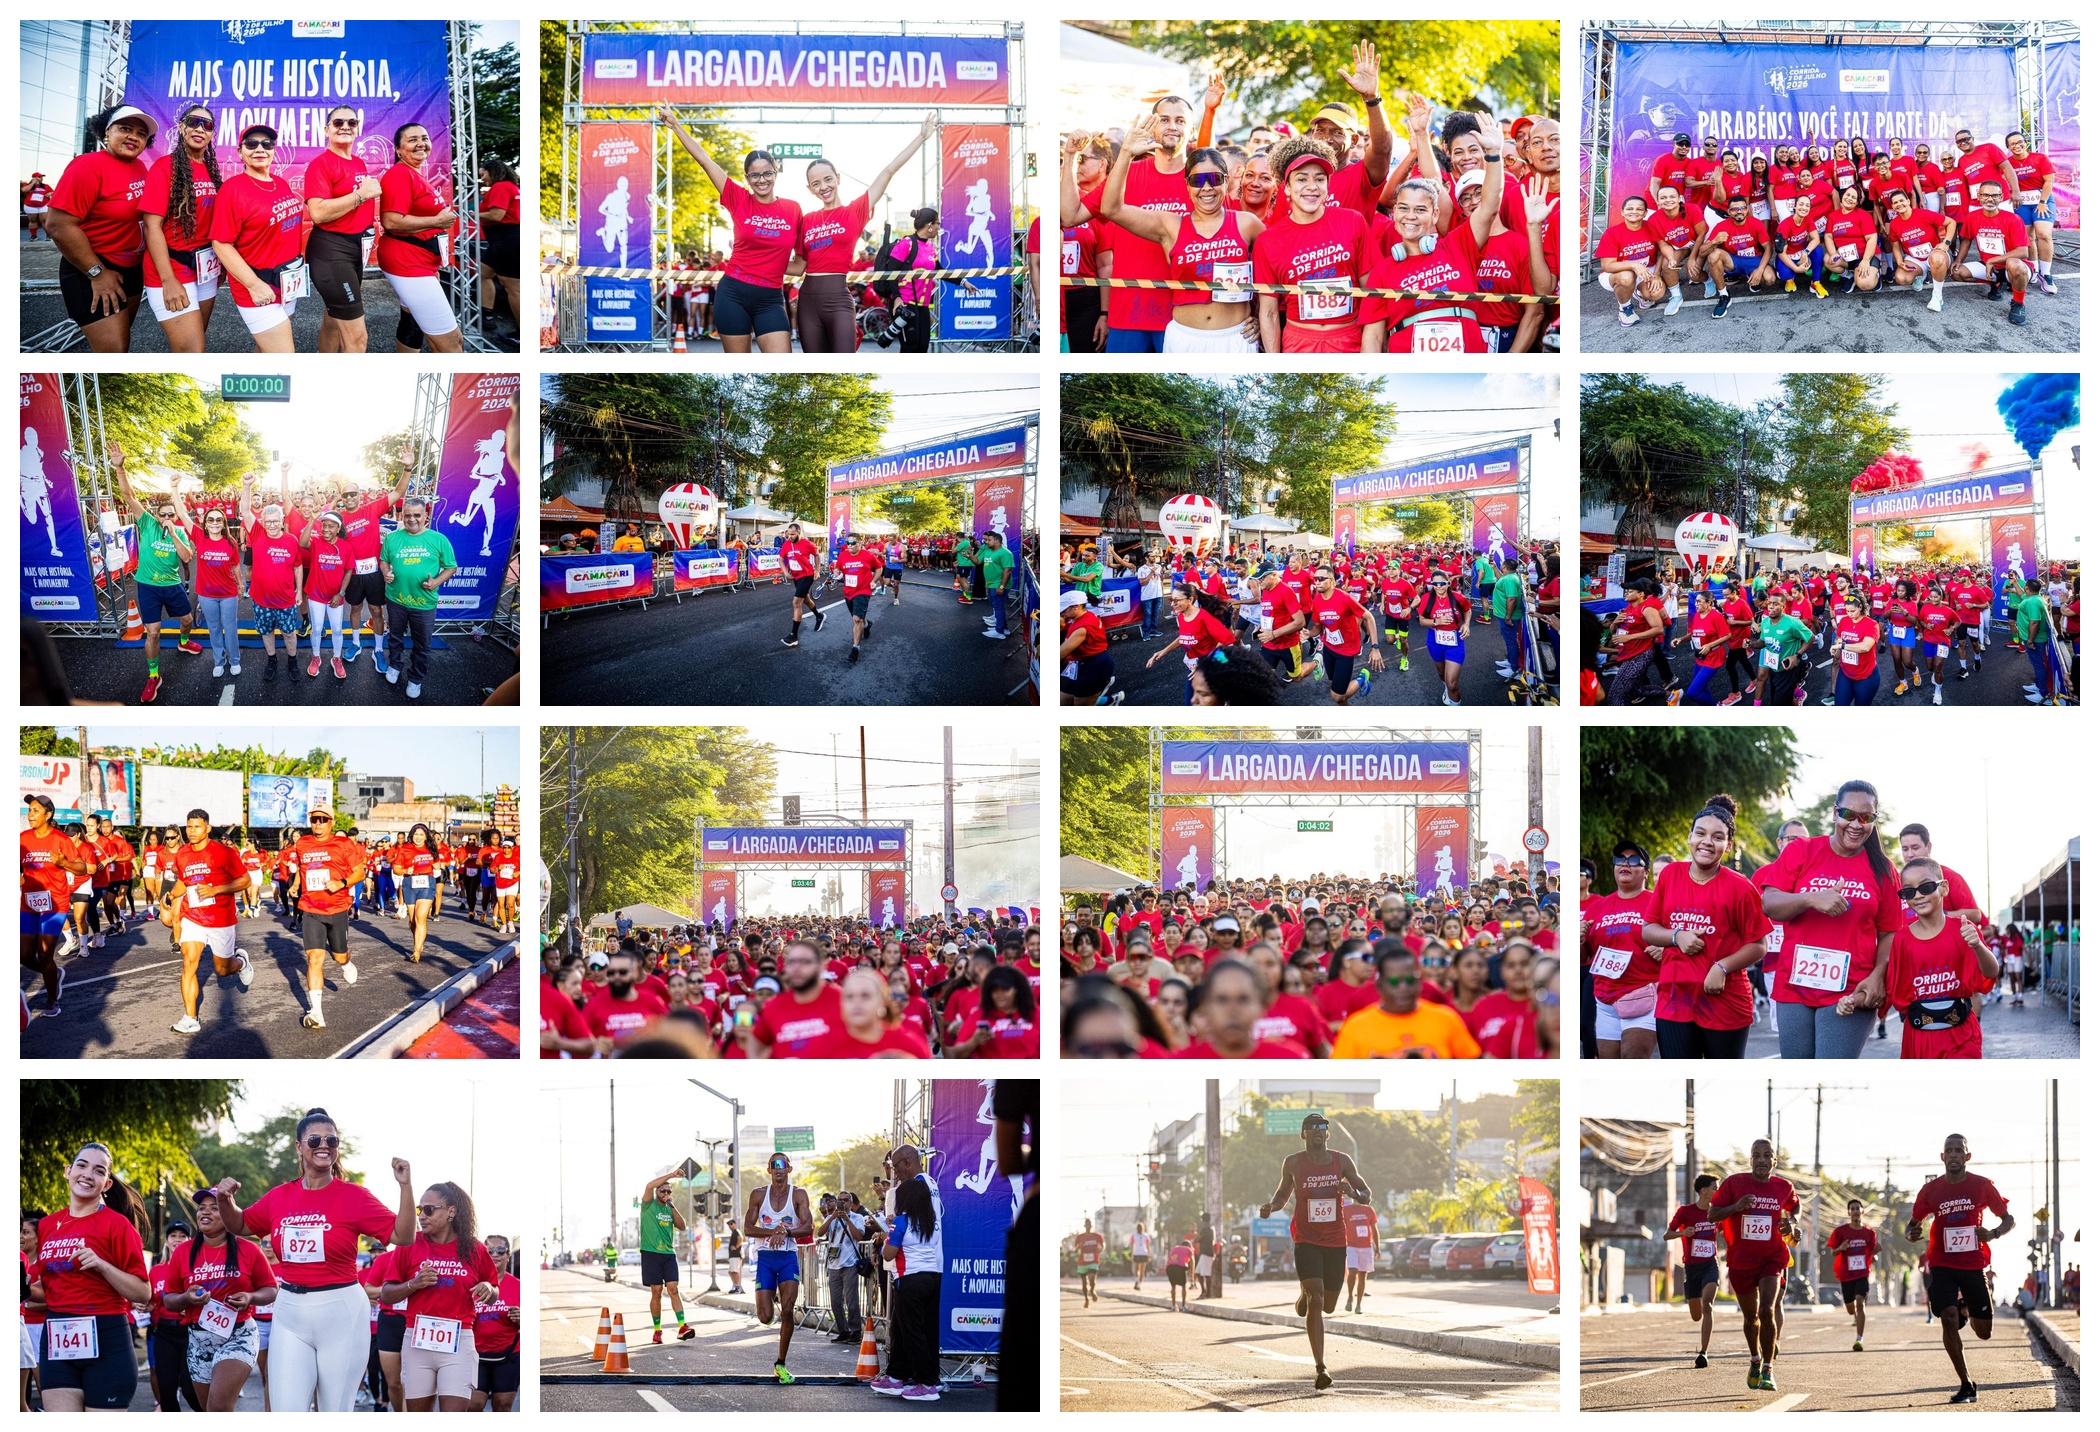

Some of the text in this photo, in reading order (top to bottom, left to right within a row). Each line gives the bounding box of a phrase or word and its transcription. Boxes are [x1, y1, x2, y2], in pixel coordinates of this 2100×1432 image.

[243, 28, 266, 36] 2026
[168, 51, 401, 102] MAIS QUE HISTÓRIA,
[646, 50, 947, 88] LARGADA/CHEGADA
[1786, 81, 1808, 89] 2026
[1699, 105, 1949, 140] PARABÉNS! VOCÊ FAZ PARTE DA
[1183, 239, 1238, 254] CORRIDA
[1985, 242, 1996, 250] 72
[1185, 252, 1203, 264] DE
[1204, 247, 1243, 261] JULHO
[1292, 243, 1344, 266] CORRIDA
[1296, 263, 1312, 277] DE
[1313, 251, 1351, 271] JULHO
[1399, 262, 1453, 288] CORRIDA
[1421, 270, 1460, 289] JULHO
[1307, 294, 1347, 309] 1882
[1418, 336, 1462, 353] 1024
[225, 378, 284, 393] 0:00:00
[476, 389, 491, 398] DE
[481, 398, 512, 410] 2026
[848, 444, 980, 483] LARGADA/CHEGADA
[1353, 462, 1478, 496] LARGADA/CHEGADA
[665, 500, 709, 511] CAMAÇARI
[1871, 484, 1994, 516] LARGADA/CHEGADA
[1165, 513, 1212, 524] CAMAÇARI
[1682, 531, 1729, 542] CAMAÇARI
[693, 562, 726, 570] CAMAÇARI
[573, 571, 629, 582] CAMAÇARI
[1208, 754, 1422, 782] LARGADA/CHEGADA
[1299, 821, 1330, 830] 0:04:02
[732, 836, 875, 854] LARGADA/CHEGADA
[29, 899, 48, 907] 1302
[1602, 912, 1641, 921] CORRIDA
[1600, 958, 1627, 973] 1884
[1798, 959, 1841, 980] 2210
[1314, 1207, 1332, 1216] 569
[1939, 1199, 1972, 1209] CORRIDA
[1952, 1204, 1976, 1214] JULHO
[280, 1213, 327, 1225] CORRIDA
[1746, 1223, 1771, 1234] 1269
[42, 1237, 85, 1250] CORRIDA
[289, 1239, 317, 1253] 872
[1951, 1235, 1971, 1246] 277
[1694, 1245, 1712, 1253] 2083
[951, 1258, 989, 1275] MAIS QUE
[962, 1275, 967, 1293] É
[206, 1310, 230, 1329] 940
[957, 1316, 1001, 1326] CAMAÇARI
[55, 1332, 89, 1349] 1641
[420, 1327, 452, 1344] 1101
